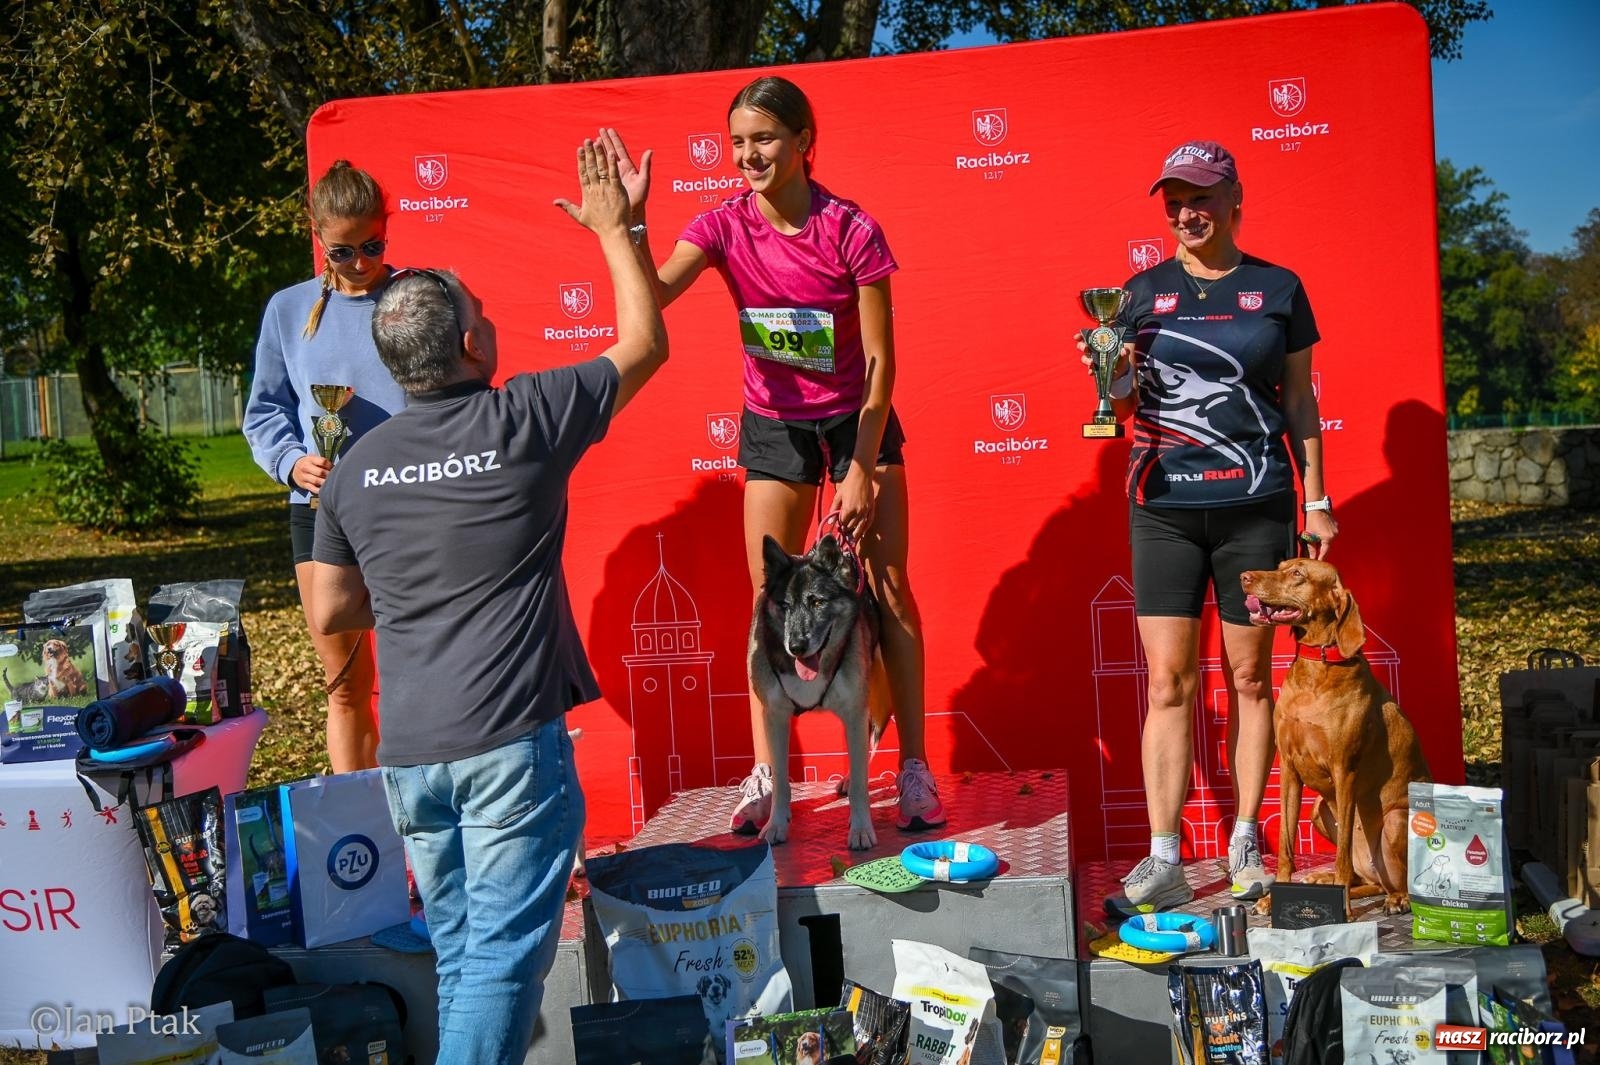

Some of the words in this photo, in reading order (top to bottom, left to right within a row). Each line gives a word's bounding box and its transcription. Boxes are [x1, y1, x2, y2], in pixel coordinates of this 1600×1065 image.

[1251, 122, 1329, 141] Racibórz
[1280, 142, 1301, 152] 1217
[956, 152, 1030, 169] Racibórz
[984, 171, 1003, 180] 1217
[672, 176, 744, 192] Racibórz
[400, 196, 469, 211] Racibórz
[699, 194, 718, 204] 1217
[425, 214, 444, 223] 1217
[544, 325, 615, 340] Racibórz
[571, 343, 589, 352] 1217
[769, 331, 804, 351] 99
[974, 437, 1048, 454] Racibórz
[1002, 456, 1021, 465] 1217
[364, 450, 502, 488] RACIBÓRZ
[1440, 823, 1467, 831] PLATINUM
[339, 850, 369, 874] PZU
[647, 879, 722, 899] BIOFEED
[0, 887, 81, 932] SiR
[1441, 899, 1469, 909] Chicken
[648, 913, 742, 944] EUPHORIA
[674, 946, 724, 973] Fresh
[733, 948, 756, 961] 52%
[920, 1000, 967, 1026] TropiDog
[1208, 1032, 1240, 1045] Adult
[1374, 1029, 1410, 1045] Fresh
[915, 1033, 957, 1058] RABBIT
[1209, 1044, 1244, 1052] Sensitive
